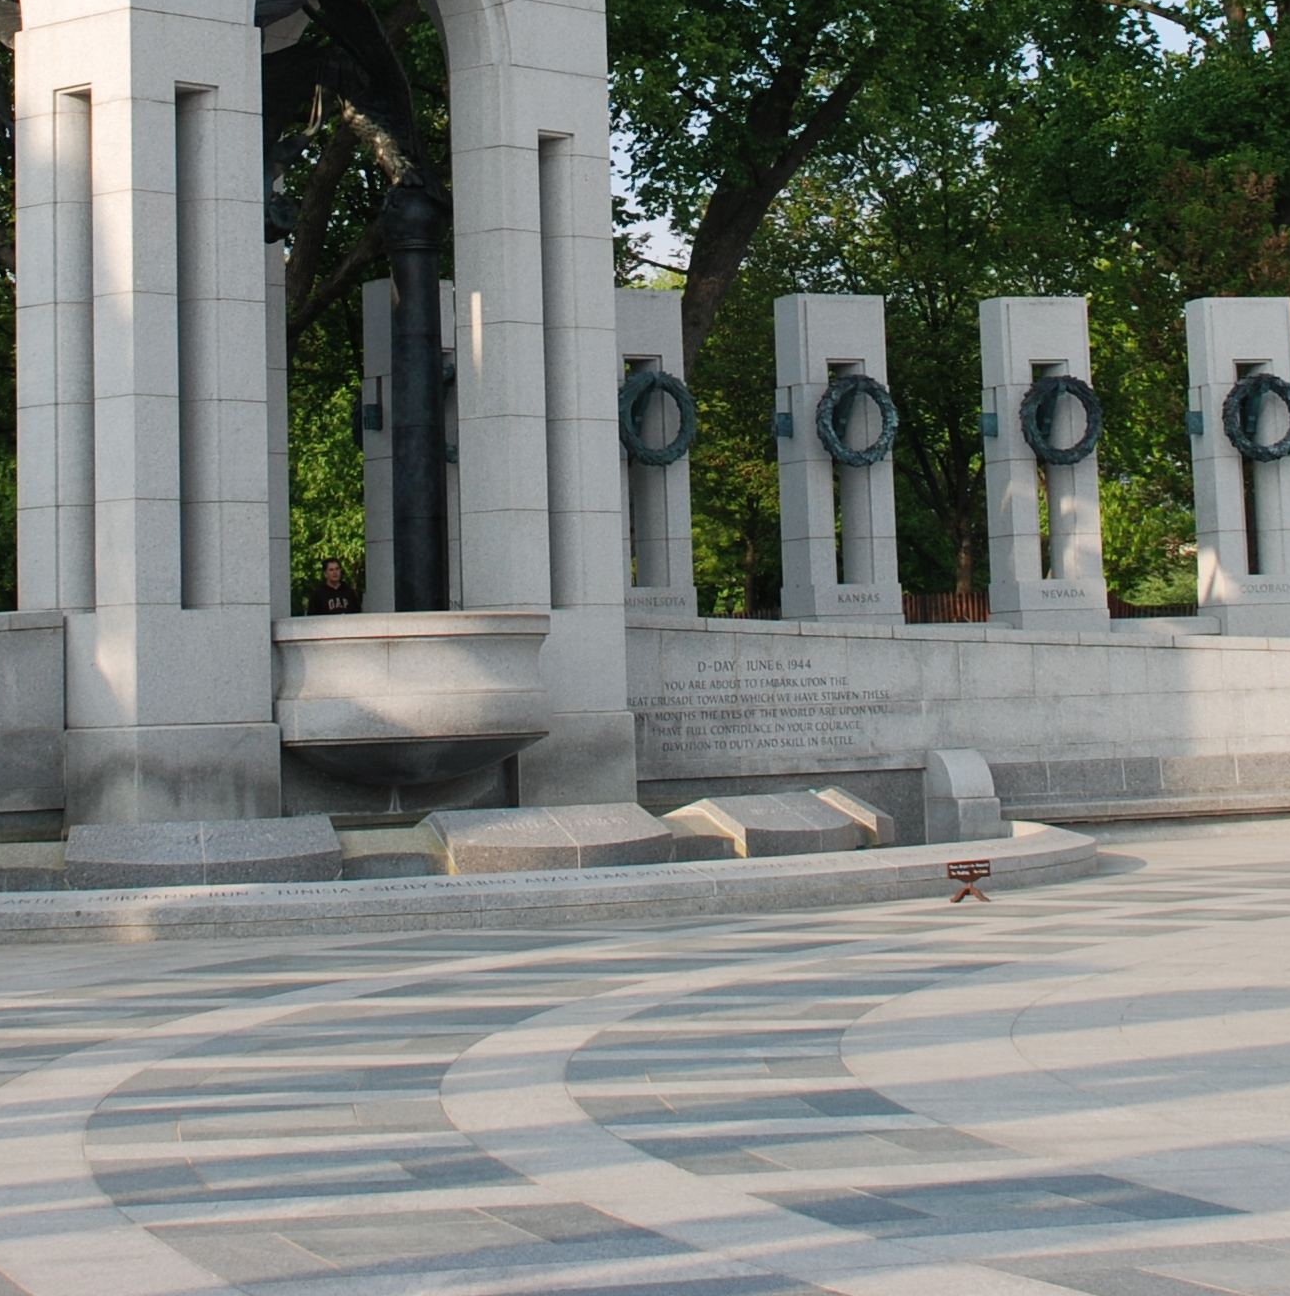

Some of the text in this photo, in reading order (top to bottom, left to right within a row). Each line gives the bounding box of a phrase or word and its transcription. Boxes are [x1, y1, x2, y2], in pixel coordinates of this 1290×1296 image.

[837, 593, 880, 603] KANSAS
[1041, 589, 1085, 598] NEVADA
[624, 597, 686, 607] MINNESOTA
[697, 660, 736, 673] D-DAY
[775, 659, 786, 672] 6,
[788, 658, 811, 670] 1944
[665, 676, 849, 691] YOU ARE ABOUT TO EMBARK UPON THE
[626, 689, 891, 707] REAT CRUSADE TOWARD WHICH WE HAVE STRIVEN THESE
[699, 709, 718, 720] THE
[720, 708, 743, 719] EYES
[743, 708, 759, 719] OF
[760, 708, 778, 718] THE
[780, 707, 816, 718] WORLD
[818, 706, 837, 716] ARE
[839, 705, 867, 716] UPON
[657, 725, 683, 736] HAVE
[685, 724, 709, 735] FULL
[710, 722, 773, 735] CONFIDENCE
[774, 723, 786, 733] IN
[787, 722, 814, 732] YOUR
[662, 740, 711, 751] DEVOTION
[714, 740, 728, 750] TO
[729, 739, 757, 749] DUTY
[757, 738, 778, 749] AND
[780, 737, 806, 748] SKILL
[808, 737, 819, 746] IN
[374, 882, 428, 892] SICILY
[434, 877, 516, 889] SALERNO
[524, 874, 579, 884] ANZIO
[584, 871, 630, 881] ROME
[88, 890, 249, 903] MURMANSK RUN
[276, 887, 352, 896] TUNISIA
